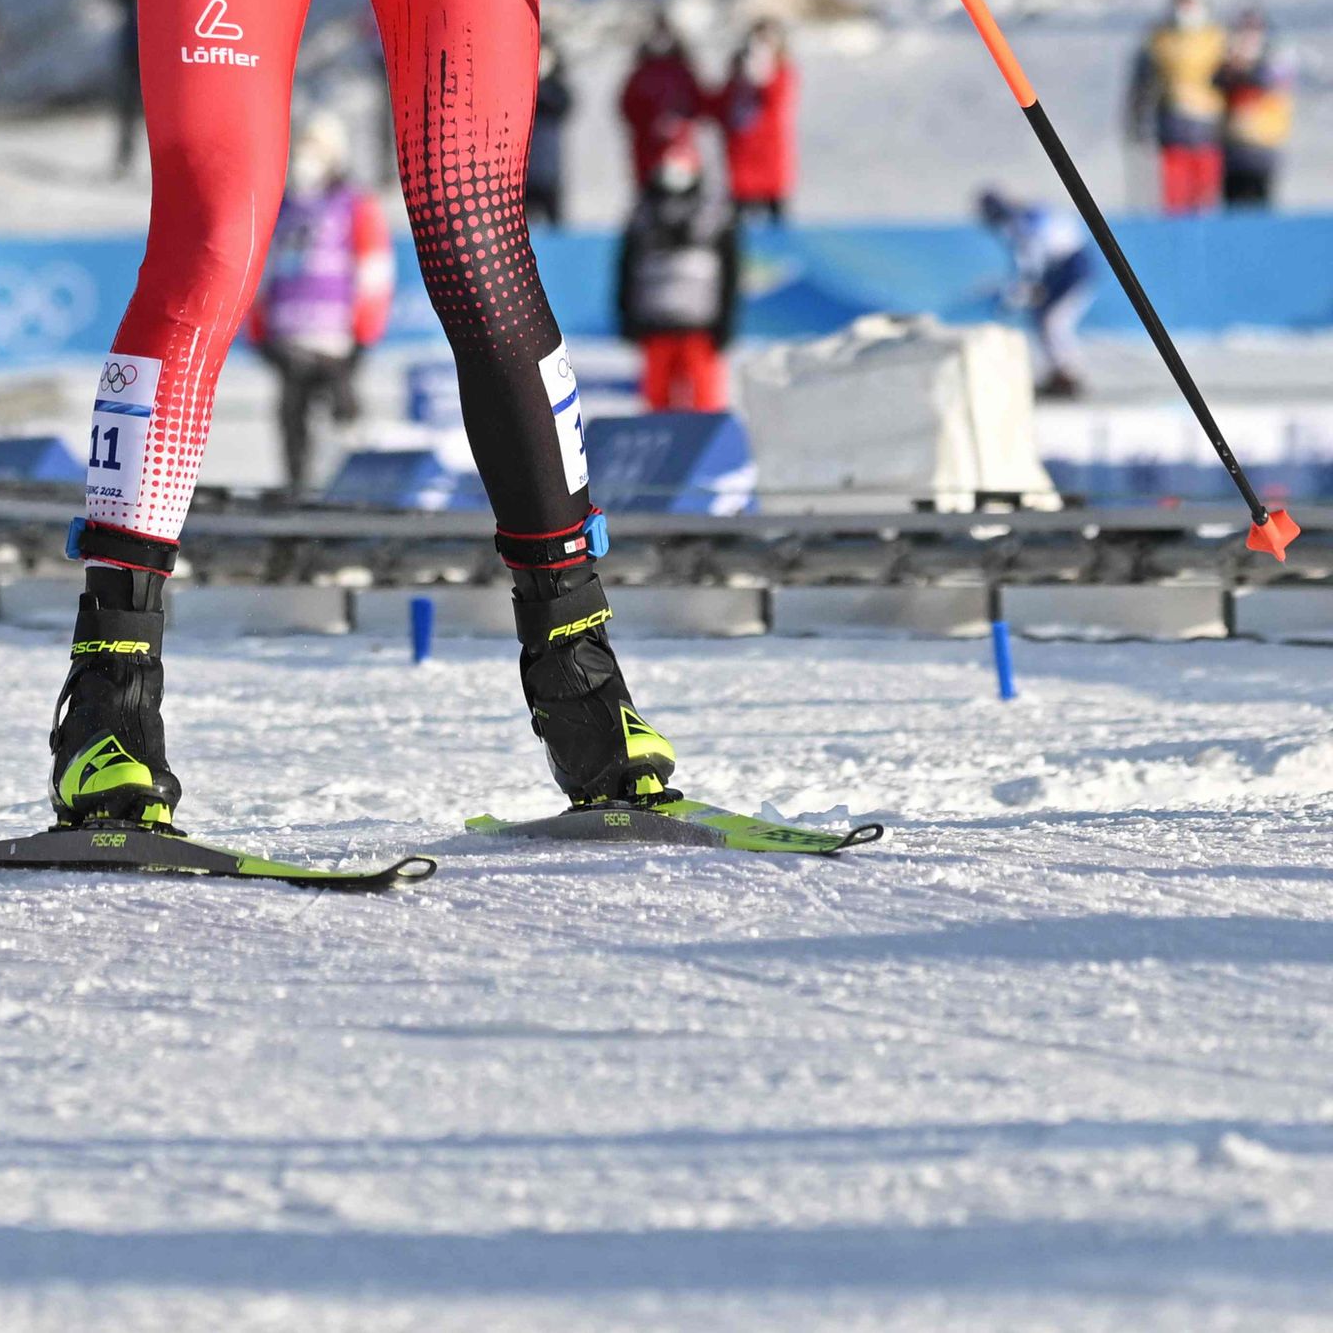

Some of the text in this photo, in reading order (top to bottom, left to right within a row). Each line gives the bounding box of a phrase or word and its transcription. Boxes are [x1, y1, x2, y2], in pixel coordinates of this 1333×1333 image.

[89, 425, 121, 470] 11
[100, 486, 124, 498] 2022
[91, 834, 127, 848] FISCHER
